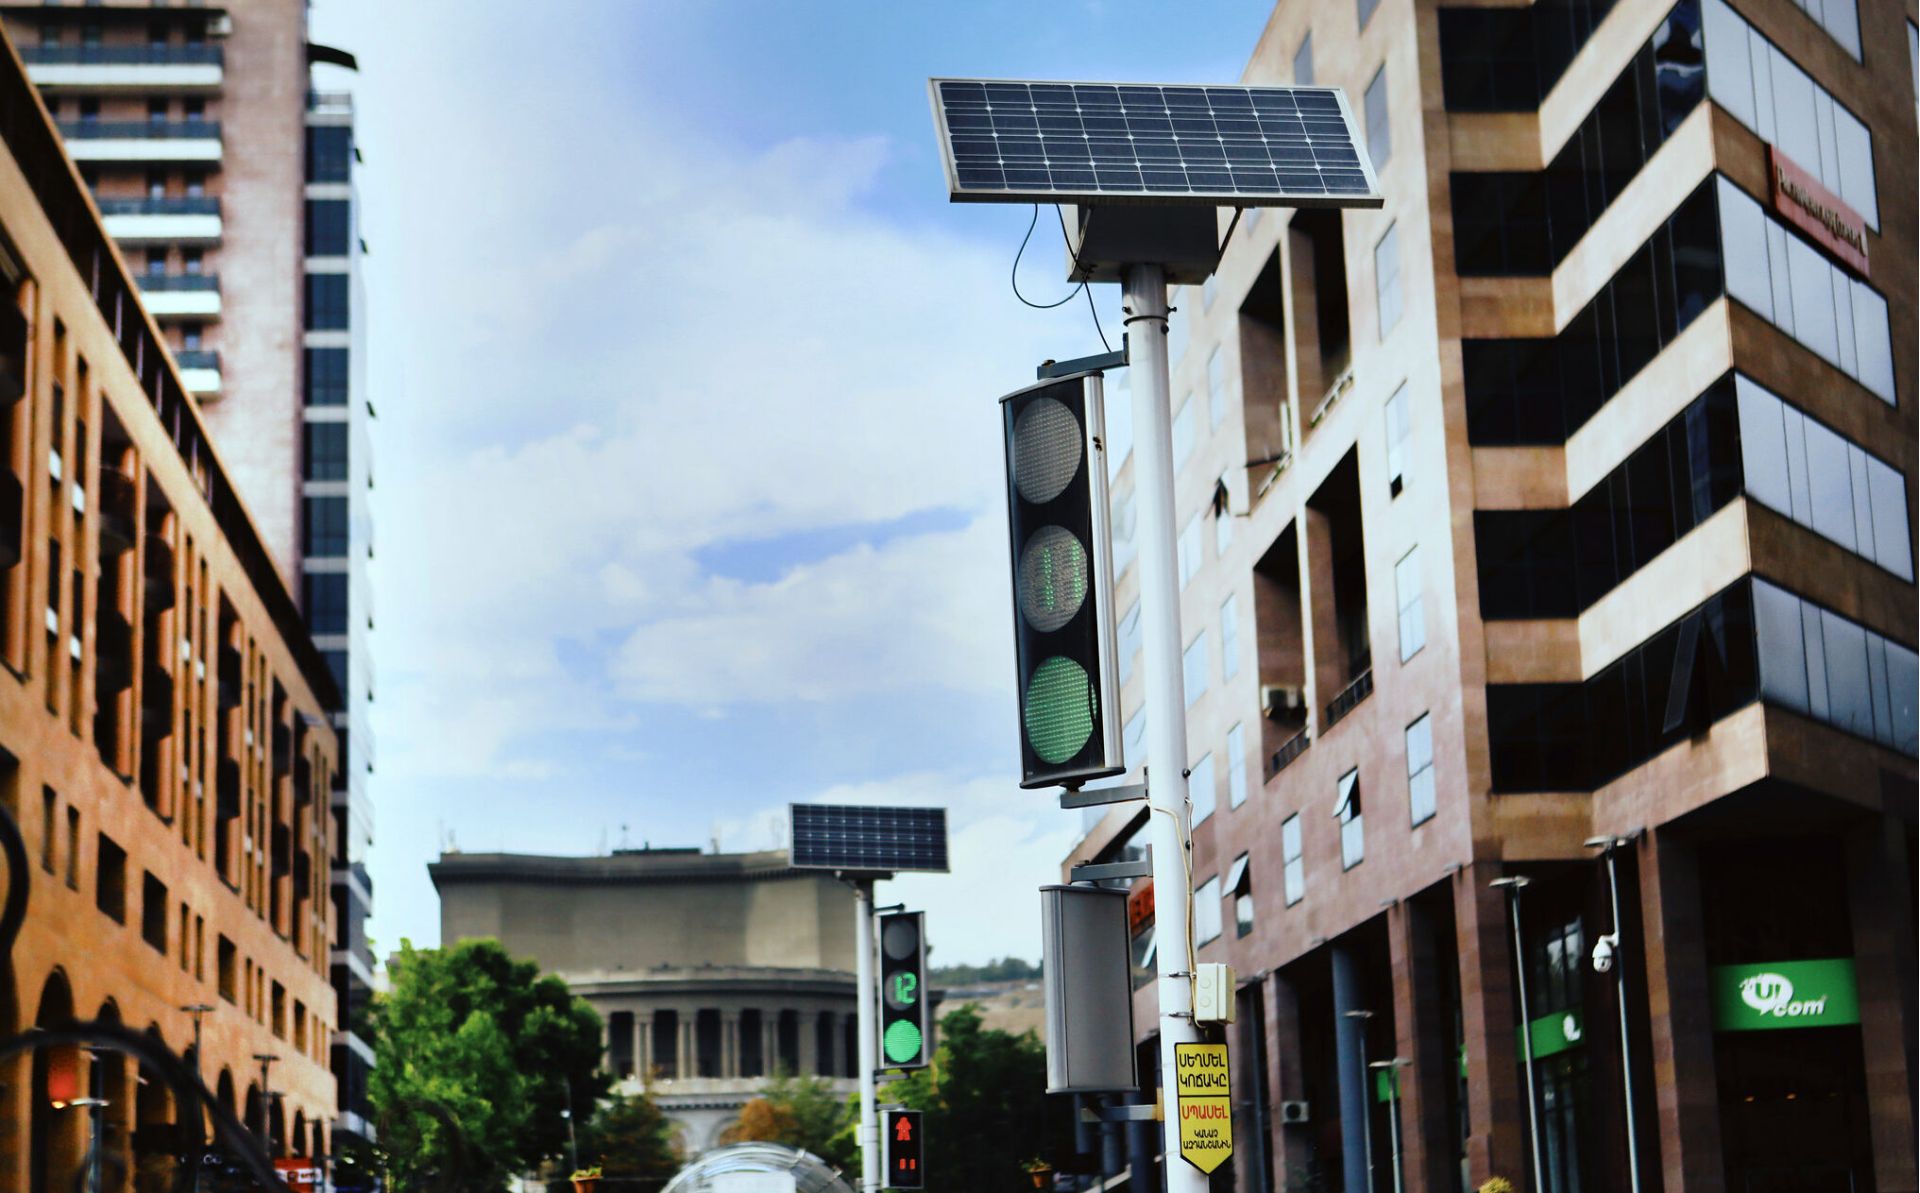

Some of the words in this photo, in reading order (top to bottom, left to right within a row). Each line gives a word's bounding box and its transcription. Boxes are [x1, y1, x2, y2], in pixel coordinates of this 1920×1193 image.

[1042, 539, 1083, 612] 11
[895, 971, 917, 1004] 12
[1179, 1053, 1226, 1068] ՍԵՂՄԵԼ
[1180, 1073, 1227, 1088] ԿՈՃԱԿԸ
[1181, 1104, 1229, 1120] ՍՊԱՍԵԼ
